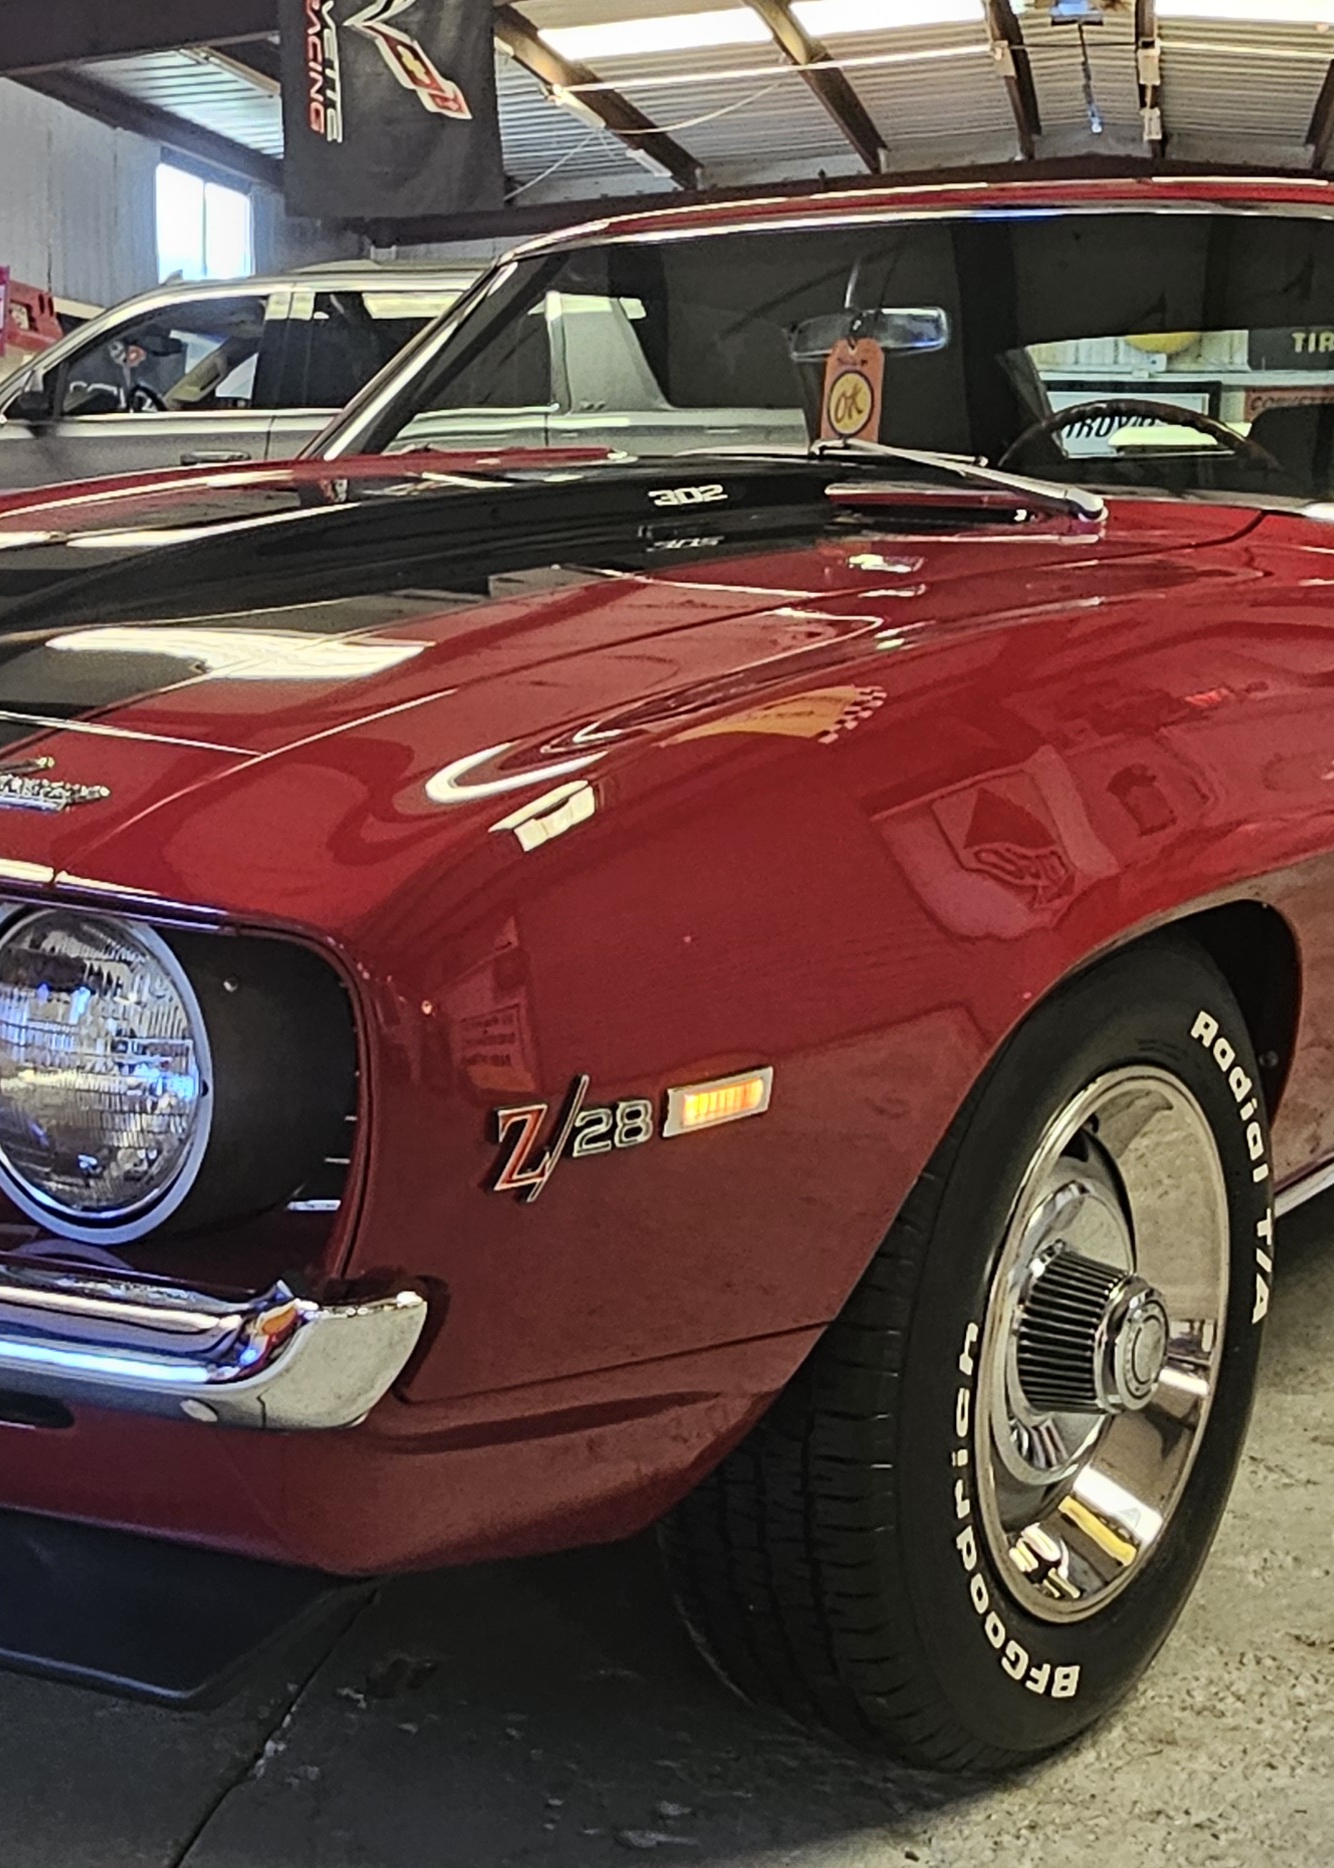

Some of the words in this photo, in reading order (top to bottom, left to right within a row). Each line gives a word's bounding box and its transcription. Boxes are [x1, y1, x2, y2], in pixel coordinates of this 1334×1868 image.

[834, 383, 865, 424] OK
[648, 484, 728, 507] 302
[493, 1073, 654, 1203] Z/28
[1190, 1010, 1270, 1183] Radial
[1251, 1207, 1273, 1325] T/A
[951, 1322, 1080, 1698] BFGoodrich
